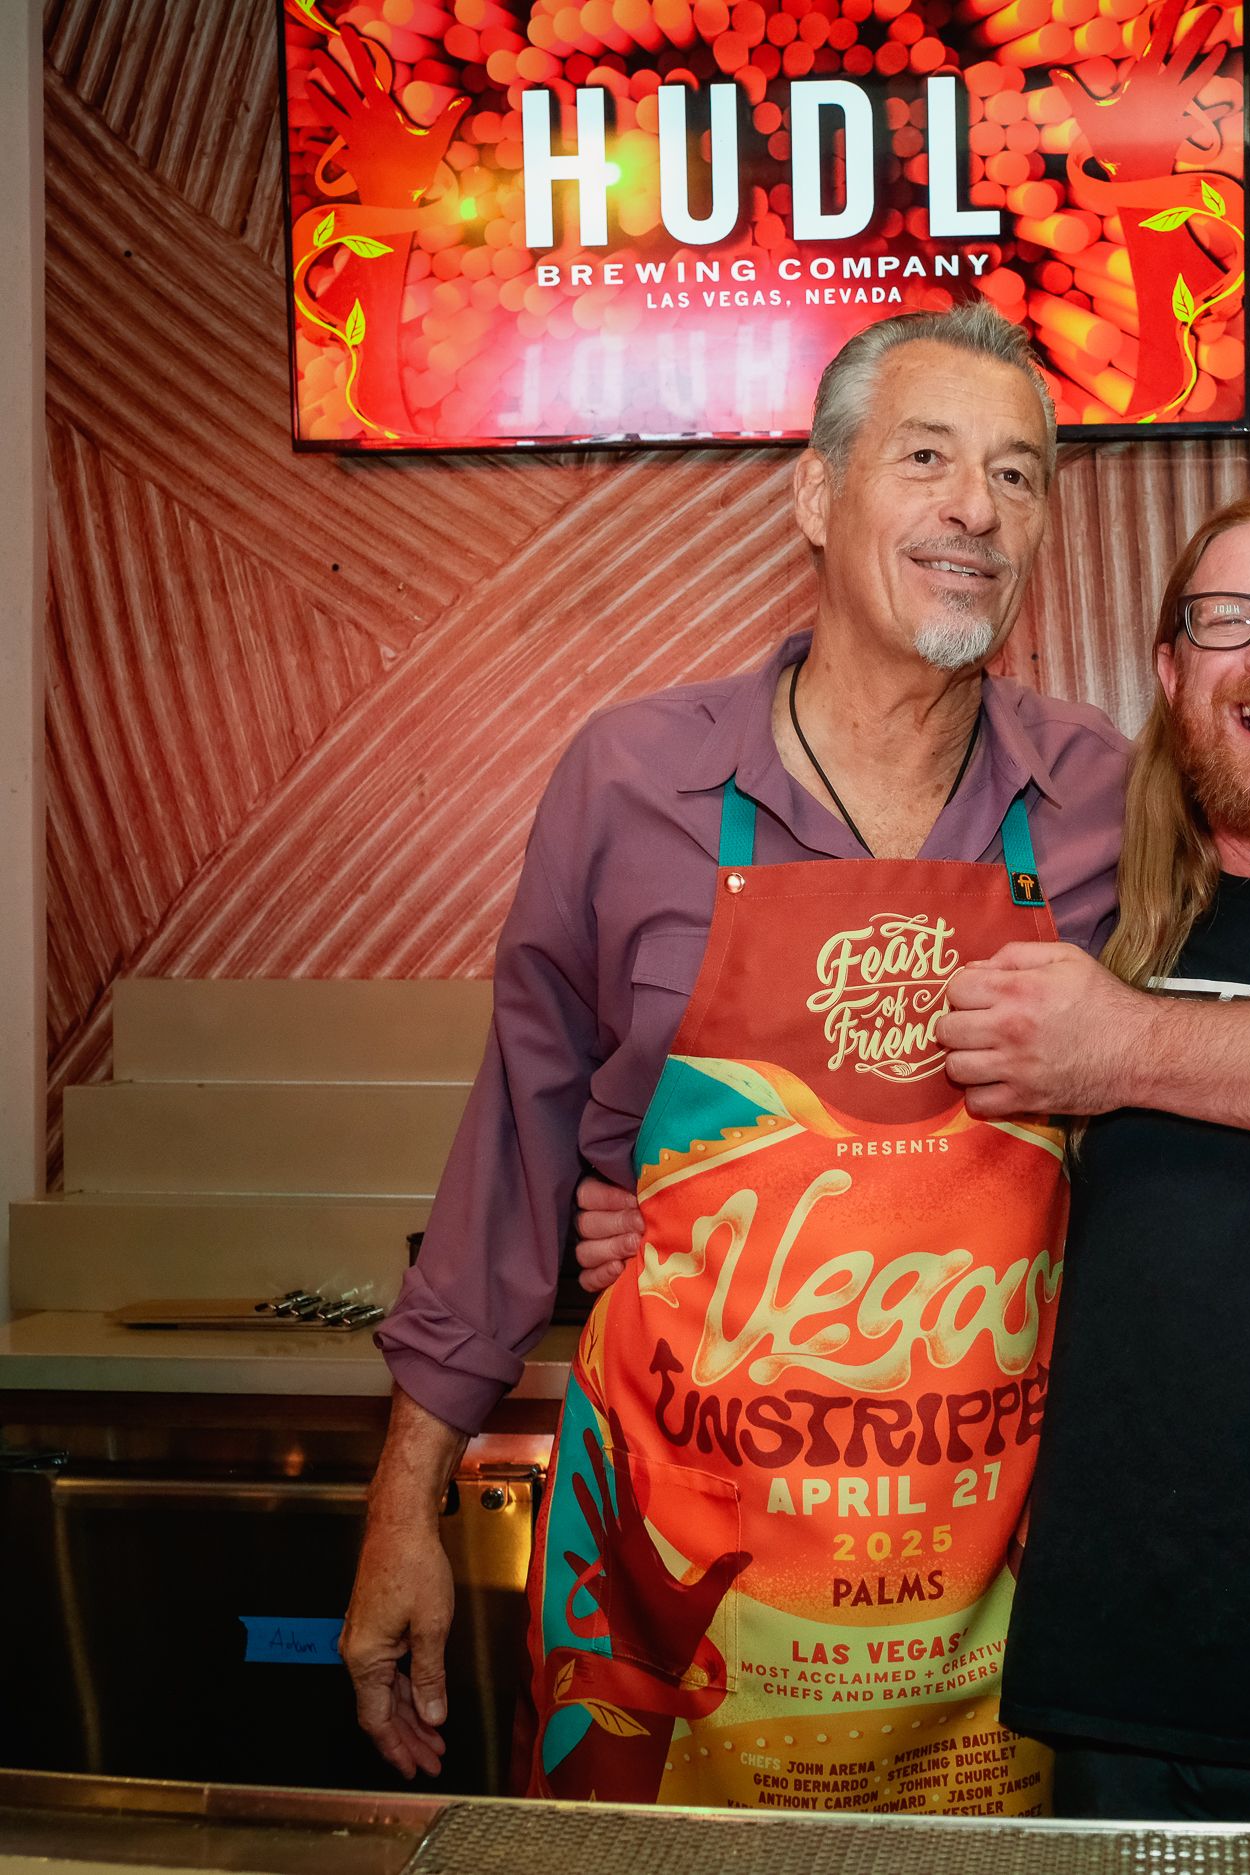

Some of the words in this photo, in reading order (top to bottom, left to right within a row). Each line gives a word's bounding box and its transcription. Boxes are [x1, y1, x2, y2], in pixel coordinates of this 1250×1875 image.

[521, 76, 1001, 248] HUDL
[537, 259, 756, 287] BREWING
[778, 254, 990, 281] COMPANY
[646, 290, 690, 309] LAS
[702, 288, 792, 308] VEGAS,
[805, 285, 903, 305] NEVADA
[806, 912, 960, 1012] Feast
[861, 986, 909, 1025] of
[836, 1137, 950, 1157] PRESENTS
[649, 1338, 1051, 1469] UNSTRIPPE
[766, 1475, 926, 1518] APRIL
[952, 1461, 1001, 1508] 27
[833, 1524, 952, 1561] 2025
[833, 1569, 944, 1608] PALMS
[741, 1661, 790, 1680] MOST
[797, 1669, 916, 1685] ACCLAIMED
[925, 1670, 934, 1679] +
[941, 1638, 1009, 1675] CREATIV
[792, 1640, 850, 1665] LAS
[763, 1682, 823, 1701] CHEFS
[831, 1690, 874, 1702] AND
[883, 1661, 998, 1700] BARTENDERS
[740, 1751, 781, 1770] CHEFS
[786, 1760, 824, 1776] JOHN
[829, 1761, 876, 1776] ARENA
[753, 1772, 789, 1790] GENO
[793, 1778, 869, 1793] BERNARDO
[887, 1756, 950, 1782] STERLING
[955, 1745, 1017, 1768] BUCKLEY
[758, 1791, 819, 1810] ANTHONY
[824, 1790, 879, 1810] CARRON
[897, 1773, 949, 1794] JOHNNY
[955, 1765, 1009, 1785] CHURCH
[873, 1794, 926, 1813] HOWARD
[947, 1785, 993, 1803] JASON
[998, 1771, 1041, 1796] JANSON
